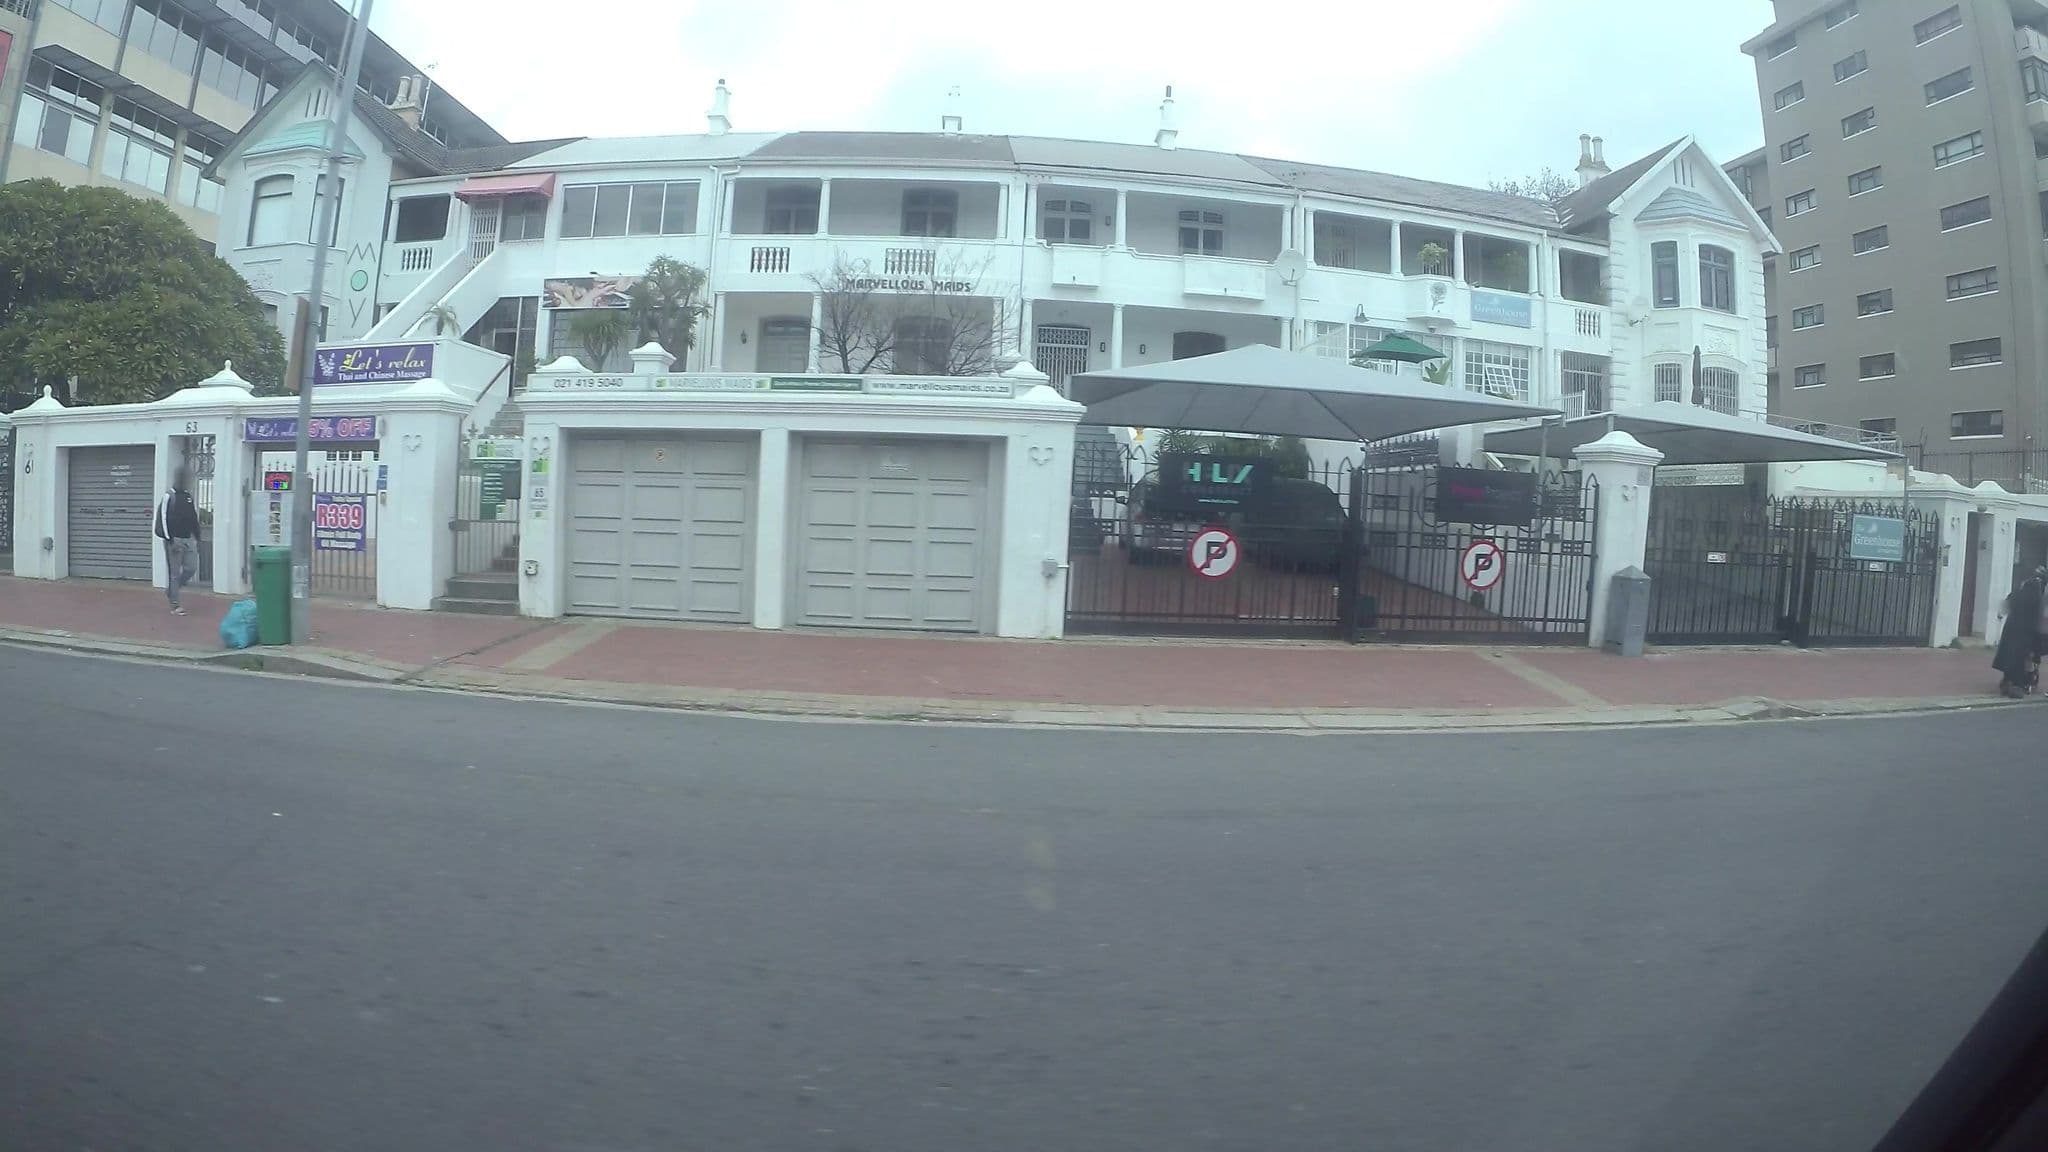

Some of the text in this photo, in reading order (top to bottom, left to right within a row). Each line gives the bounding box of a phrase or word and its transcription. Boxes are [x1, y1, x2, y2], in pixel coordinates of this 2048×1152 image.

[845, 278, 971, 292] MARVELLOUS MAIDS
[339, 346, 427, 372] Let's relax
[338, 372, 353, 381] Thai
[354, 371, 368, 380] and
[368, 370, 395, 379] Chinese
[553, 378, 623, 389] 021 419 5040
[186, 421, 198, 433] 63
[336, 417, 371, 437] OFF
[24, 460, 34, 474] 61
[316, 503, 364, 530] R339
